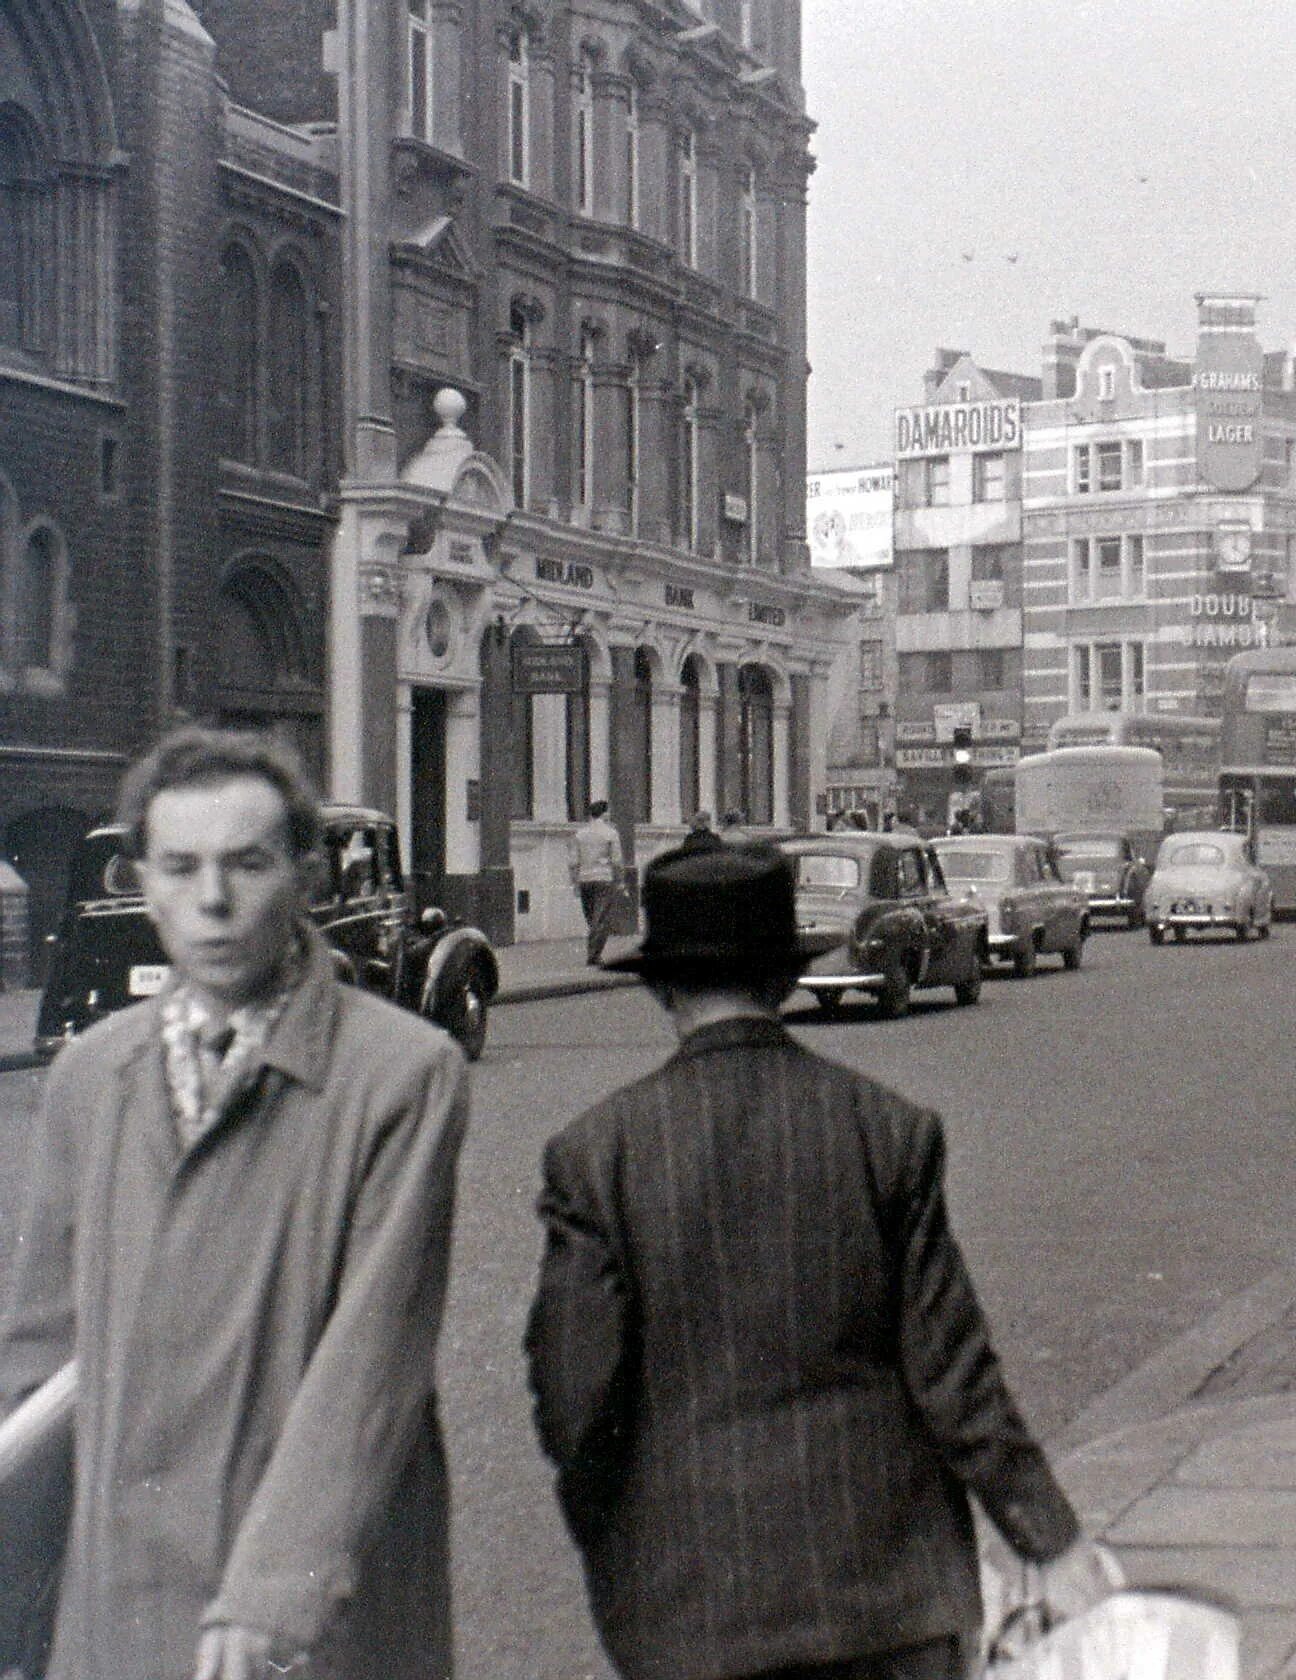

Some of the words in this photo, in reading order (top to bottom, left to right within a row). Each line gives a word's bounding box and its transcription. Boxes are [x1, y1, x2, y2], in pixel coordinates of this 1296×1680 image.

[898, 403, 1017, 452] DAMAROIDS
[1209, 424, 1253, 442] LAGER
[536, 556, 594, 589] MIDLAND
[665, 584, 695, 609] BANK
